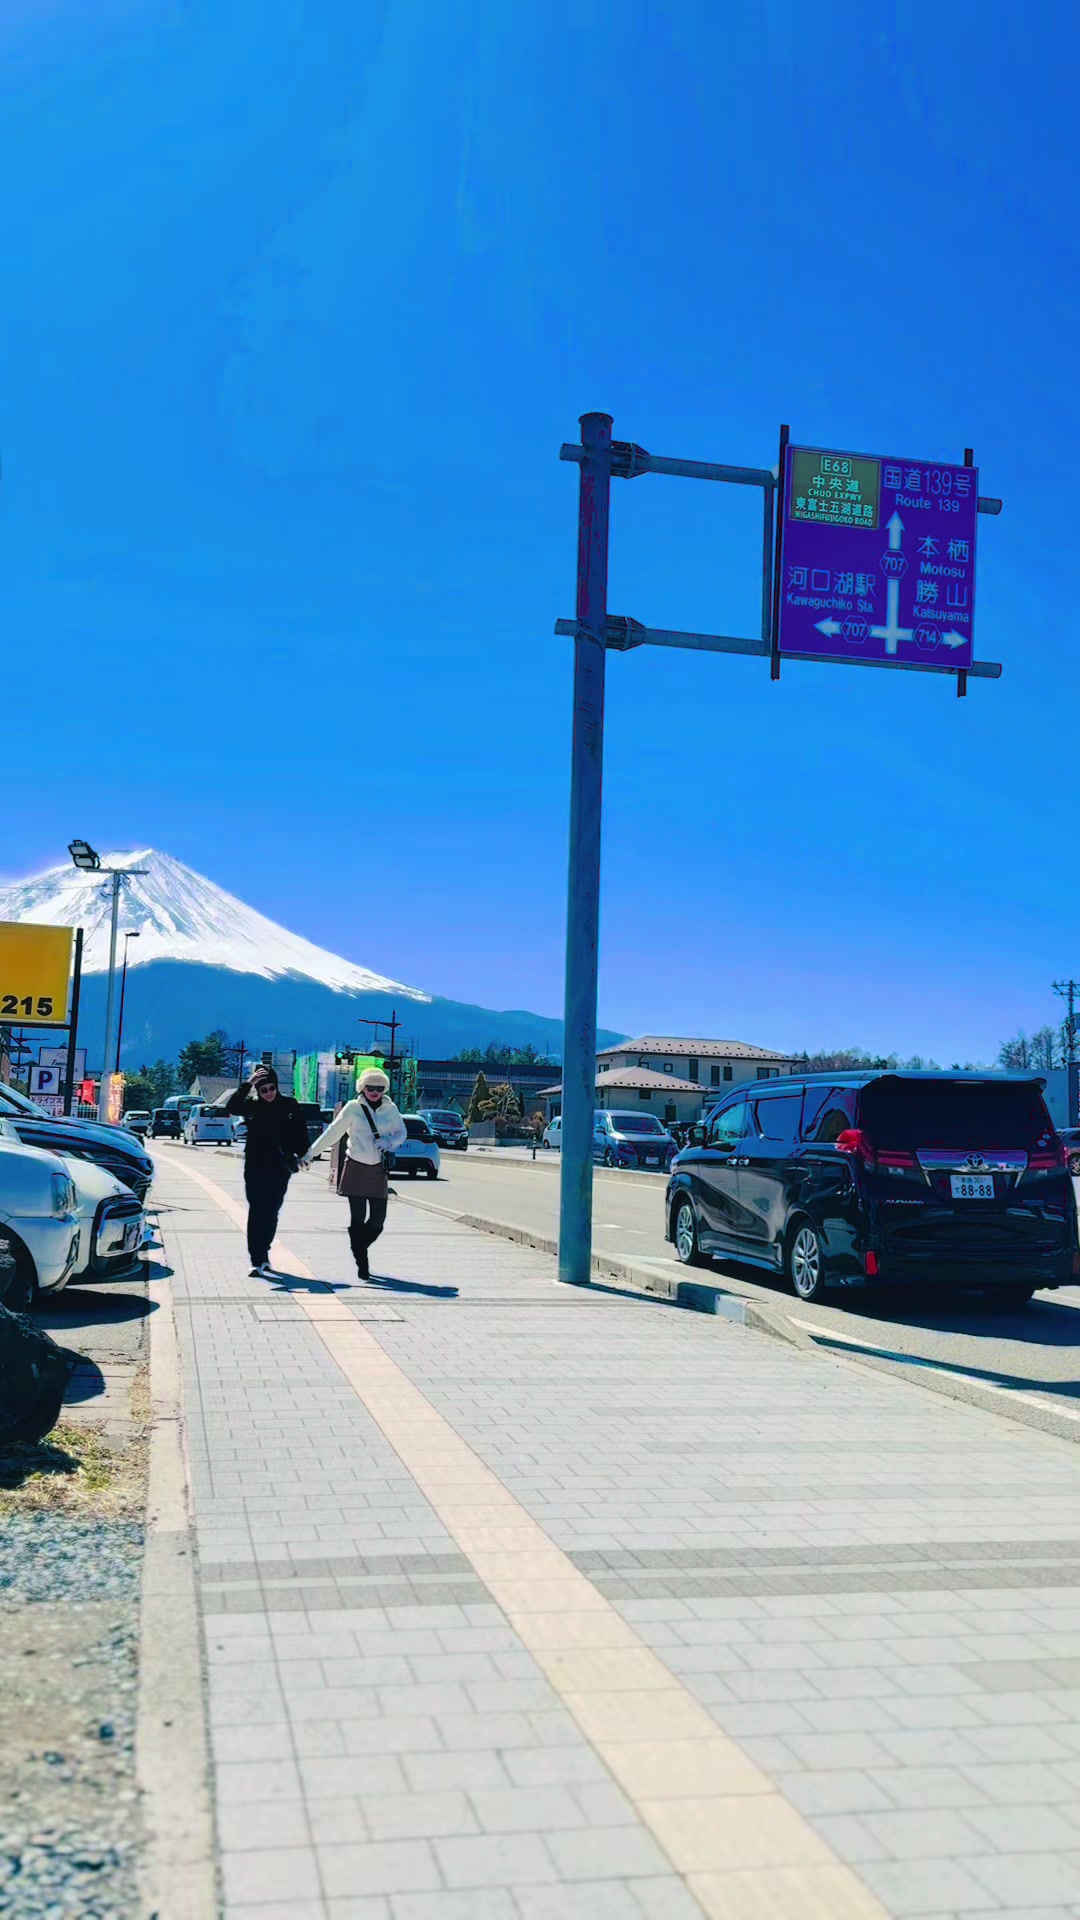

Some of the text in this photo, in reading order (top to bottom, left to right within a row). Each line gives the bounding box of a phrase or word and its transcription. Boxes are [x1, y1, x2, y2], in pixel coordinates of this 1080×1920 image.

[824, 459, 849, 473] E68
[812, 475, 860, 492] 中央道
[884, 465, 972, 497] 国道139号
[808, 488, 863, 501] CHUO EXPWY
[895, 493, 960, 513] Route 139
[795, 497, 874, 518] 東富士五湖道路
[854, 517, 873, 527] ROAD
[916, 535, 970, 563] 本栖
[883, 556, 905, 572] 707
[920, 561, 966, 579] Motosu
[787, 566, 877, 598] 河口湖駅
[786, 592, 853, 610] Kawaguchiko
[915, 579, 967, 607] 勝山
[913, 605, 970, 623] Katsuyama
[845, 622, 867, 637] 707
[919, 629, 937, 644] 714
[1, 995, 53, 1017] 215
[38, 1070, 53, 1090] P
[961, 1184, 992, 1197] 88-88
